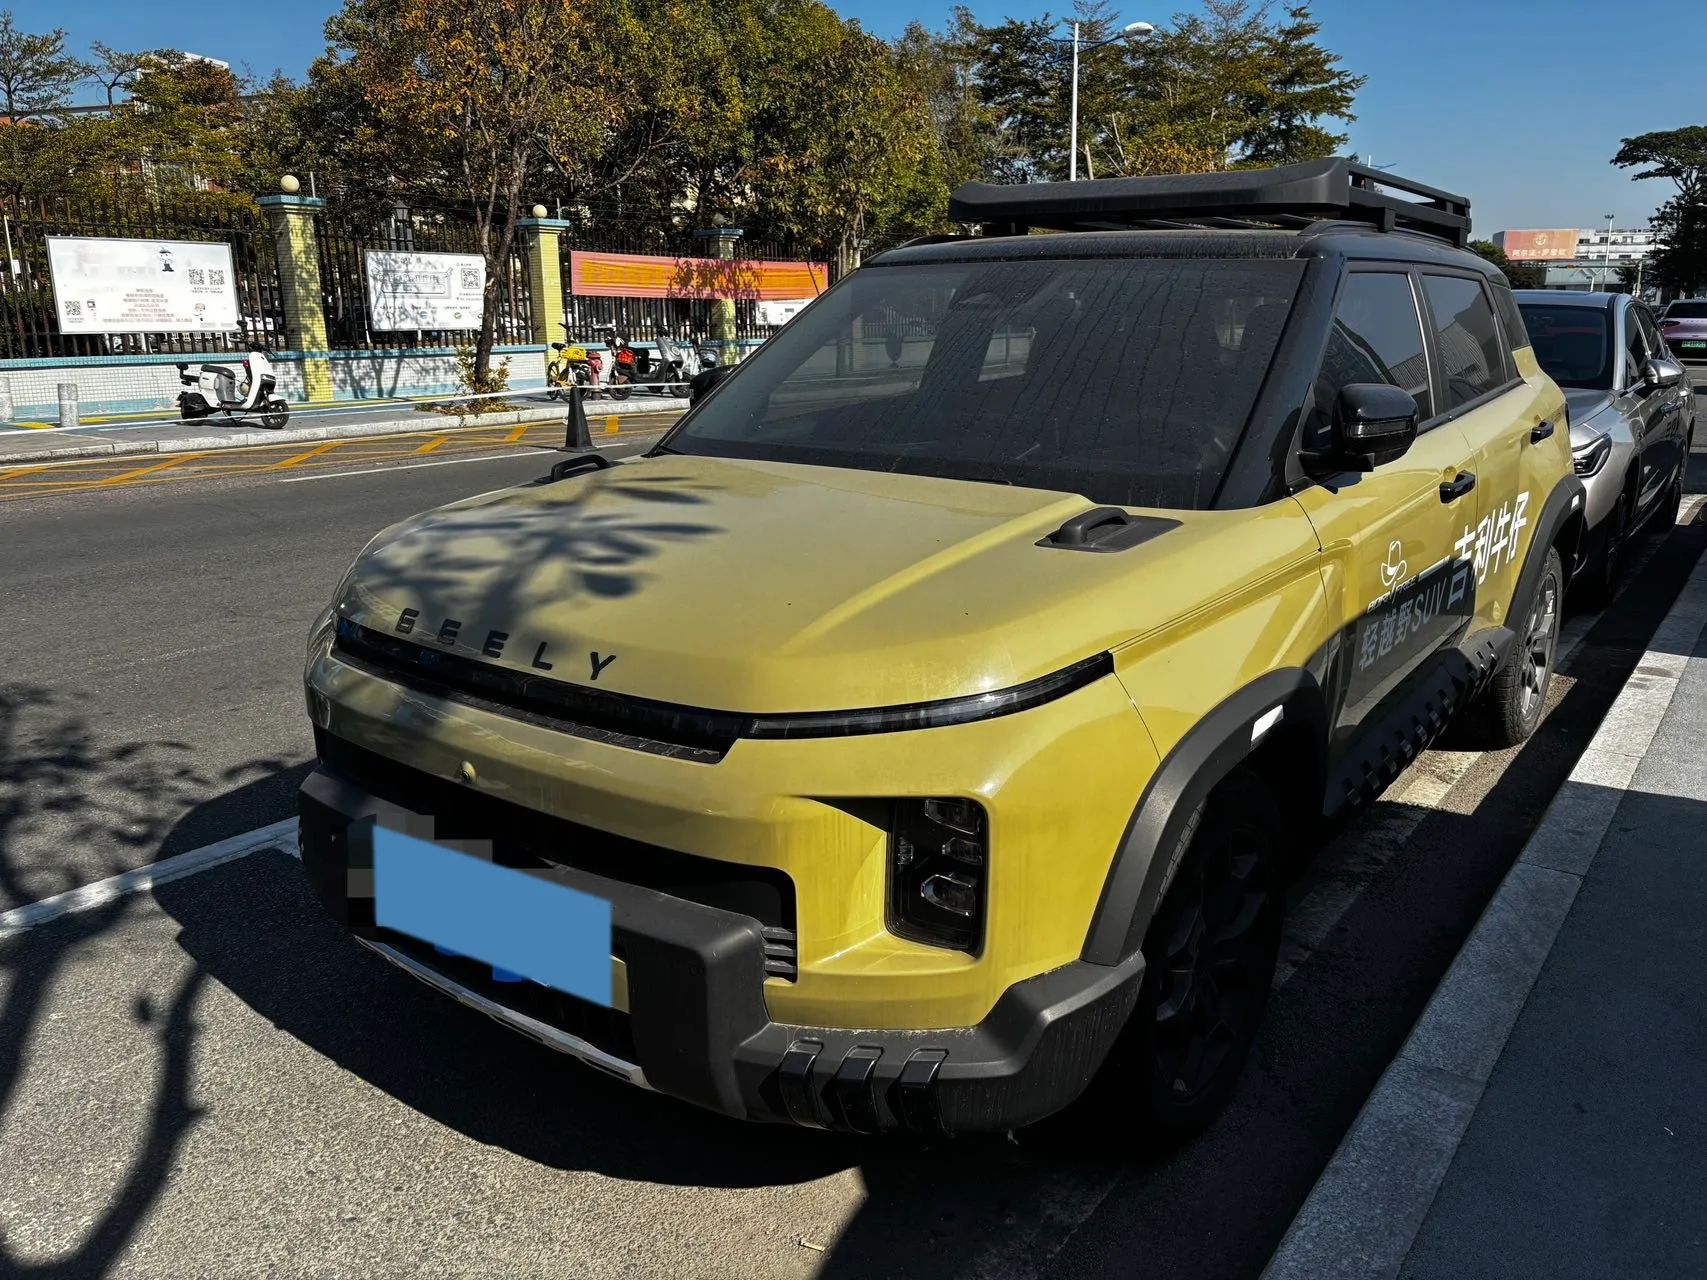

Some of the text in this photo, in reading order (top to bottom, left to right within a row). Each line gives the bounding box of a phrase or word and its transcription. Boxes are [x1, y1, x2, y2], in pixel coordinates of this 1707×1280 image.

[1447, 491, 1530, 609] 吉利牛仔
[394, 607, 617, 681] GEELY
[1359, 577, 1447, 671] 轻越野SUV
